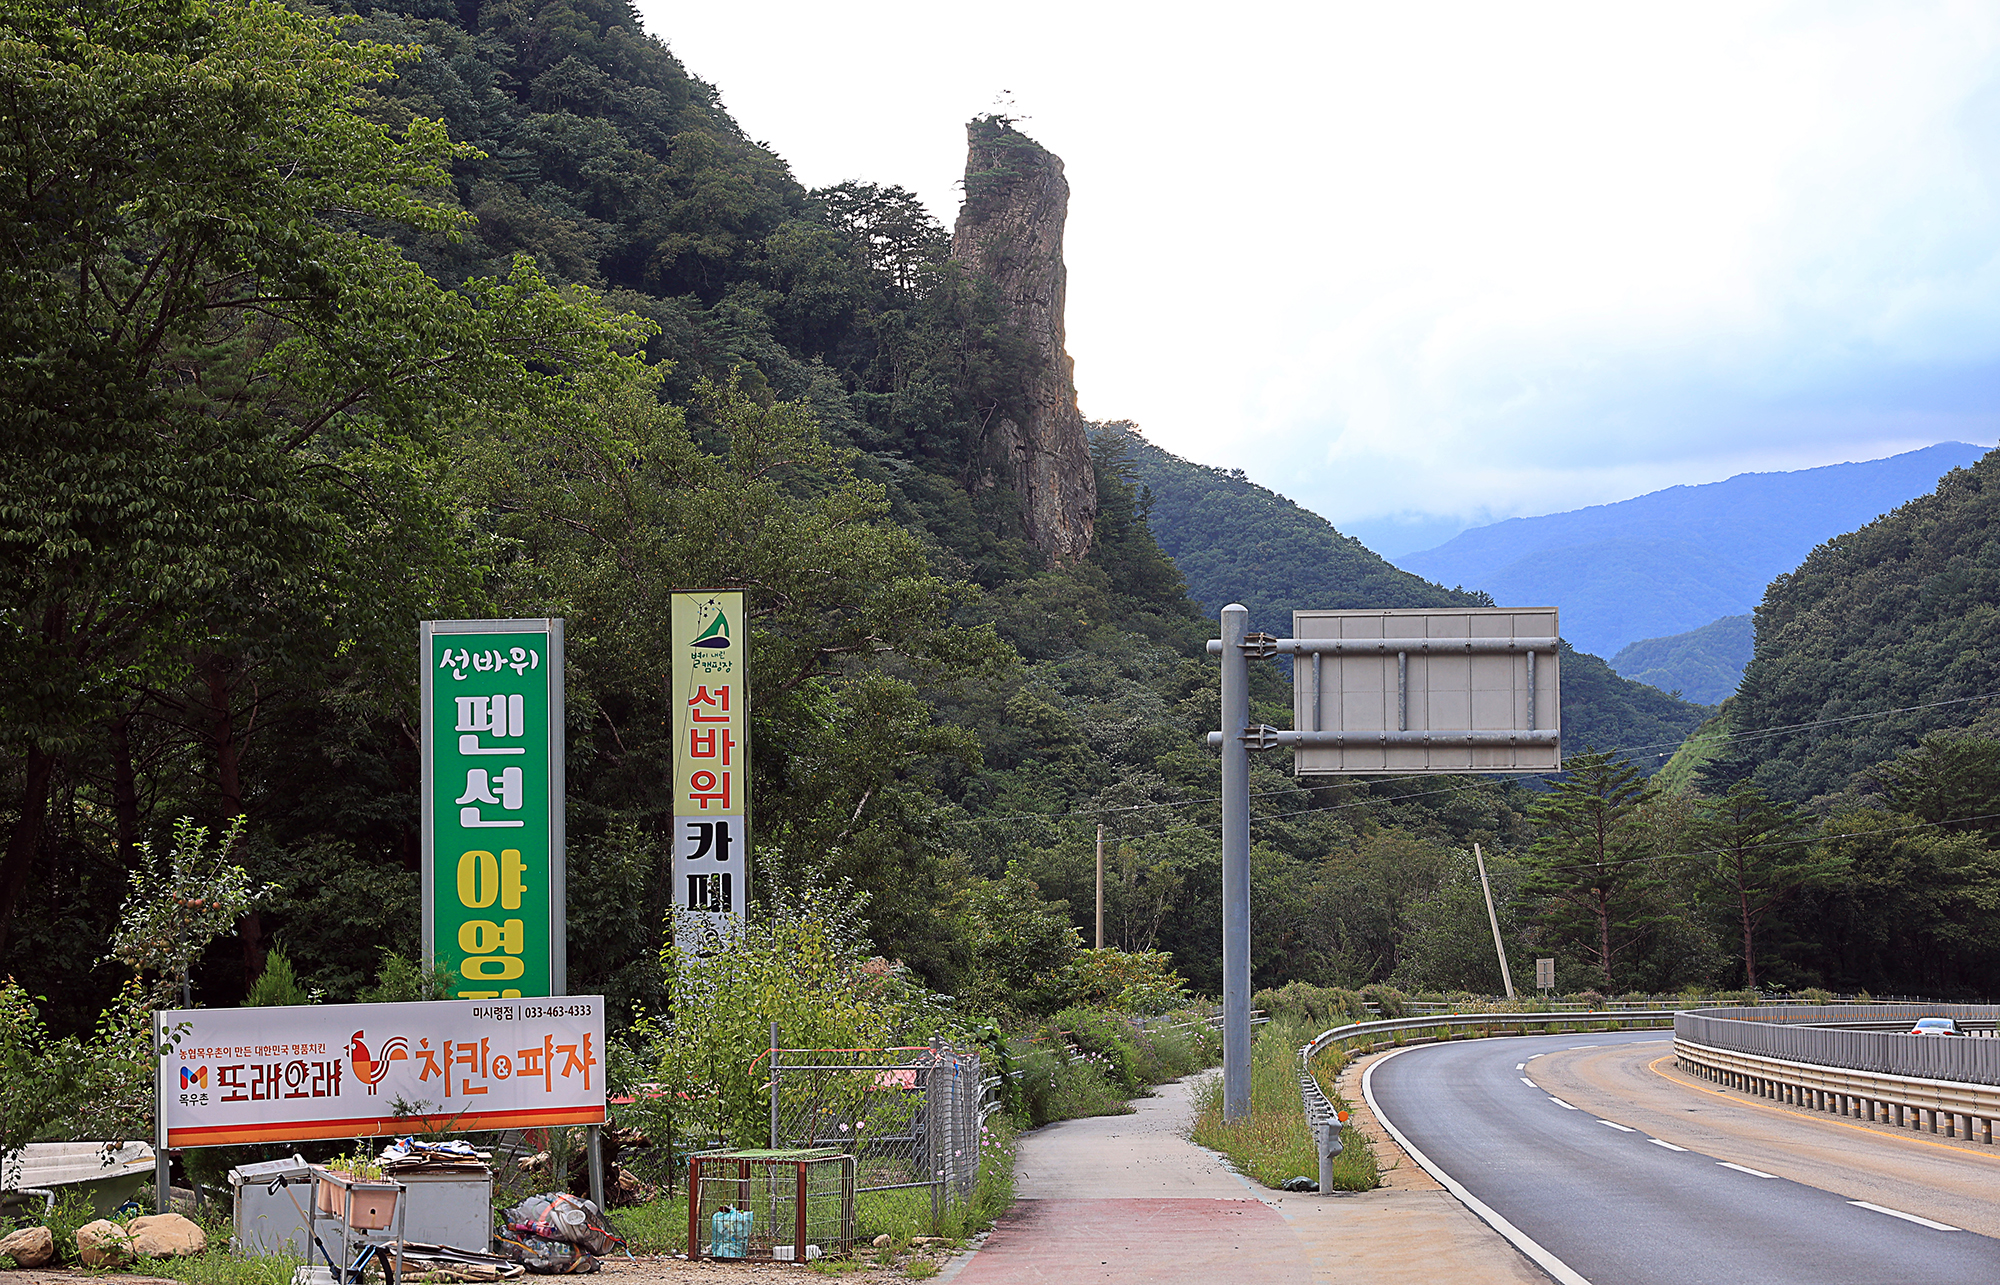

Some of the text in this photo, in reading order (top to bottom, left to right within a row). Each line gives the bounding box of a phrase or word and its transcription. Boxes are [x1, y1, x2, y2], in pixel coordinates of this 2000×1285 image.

[439, 647, 539, 681] 선바위
[701, 661, 733, 673] 캠핑장
[711, 650, 726, 660] 내린
[688, 684, 737, 811] 선바위
[454, 693, 528, 998] 펜션 야영
[686, 821, 733, 913] 카페
[473, 1004, 592, 1021] 미시령점 033-463-4333
[179, 1043, 326, 1060] 농협목우촌이 만든 대한민국 명품치킨
[216, 1058, 343, 1102] 또래오래
[179, 1093, 209, 1107] 목우촌
